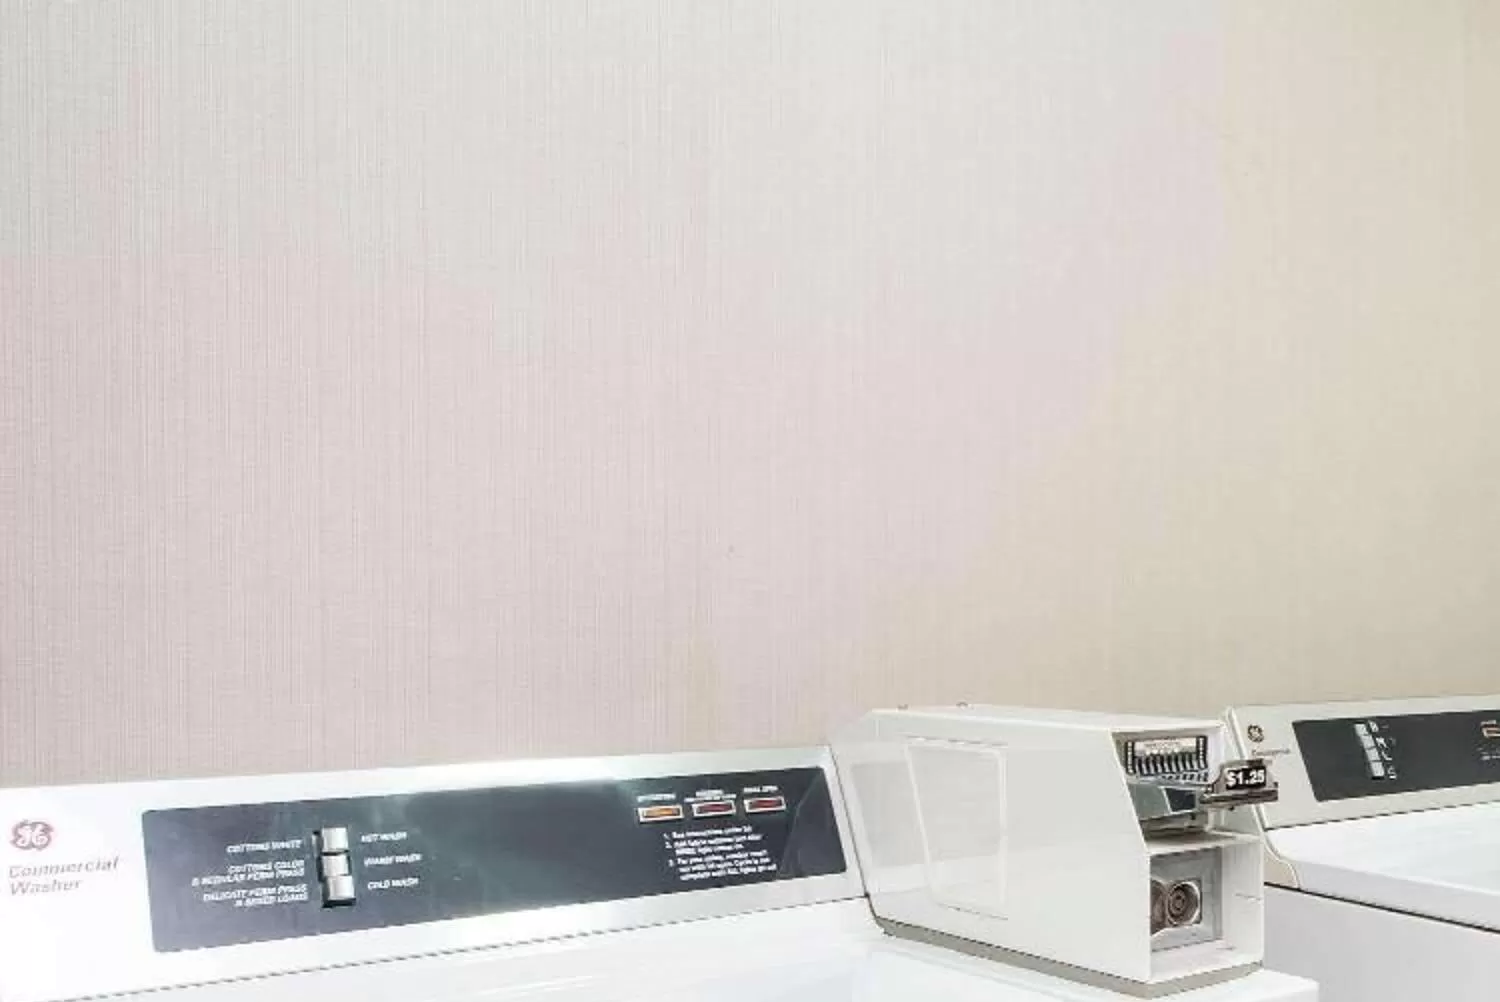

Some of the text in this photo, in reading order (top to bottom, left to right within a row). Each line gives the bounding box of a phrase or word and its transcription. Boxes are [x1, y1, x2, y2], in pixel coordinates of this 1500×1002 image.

[1225, 769, 1265, 788] $1.25
[9, 855, 119, 878] Commercial
[11, 879, 80, 896] Washer
